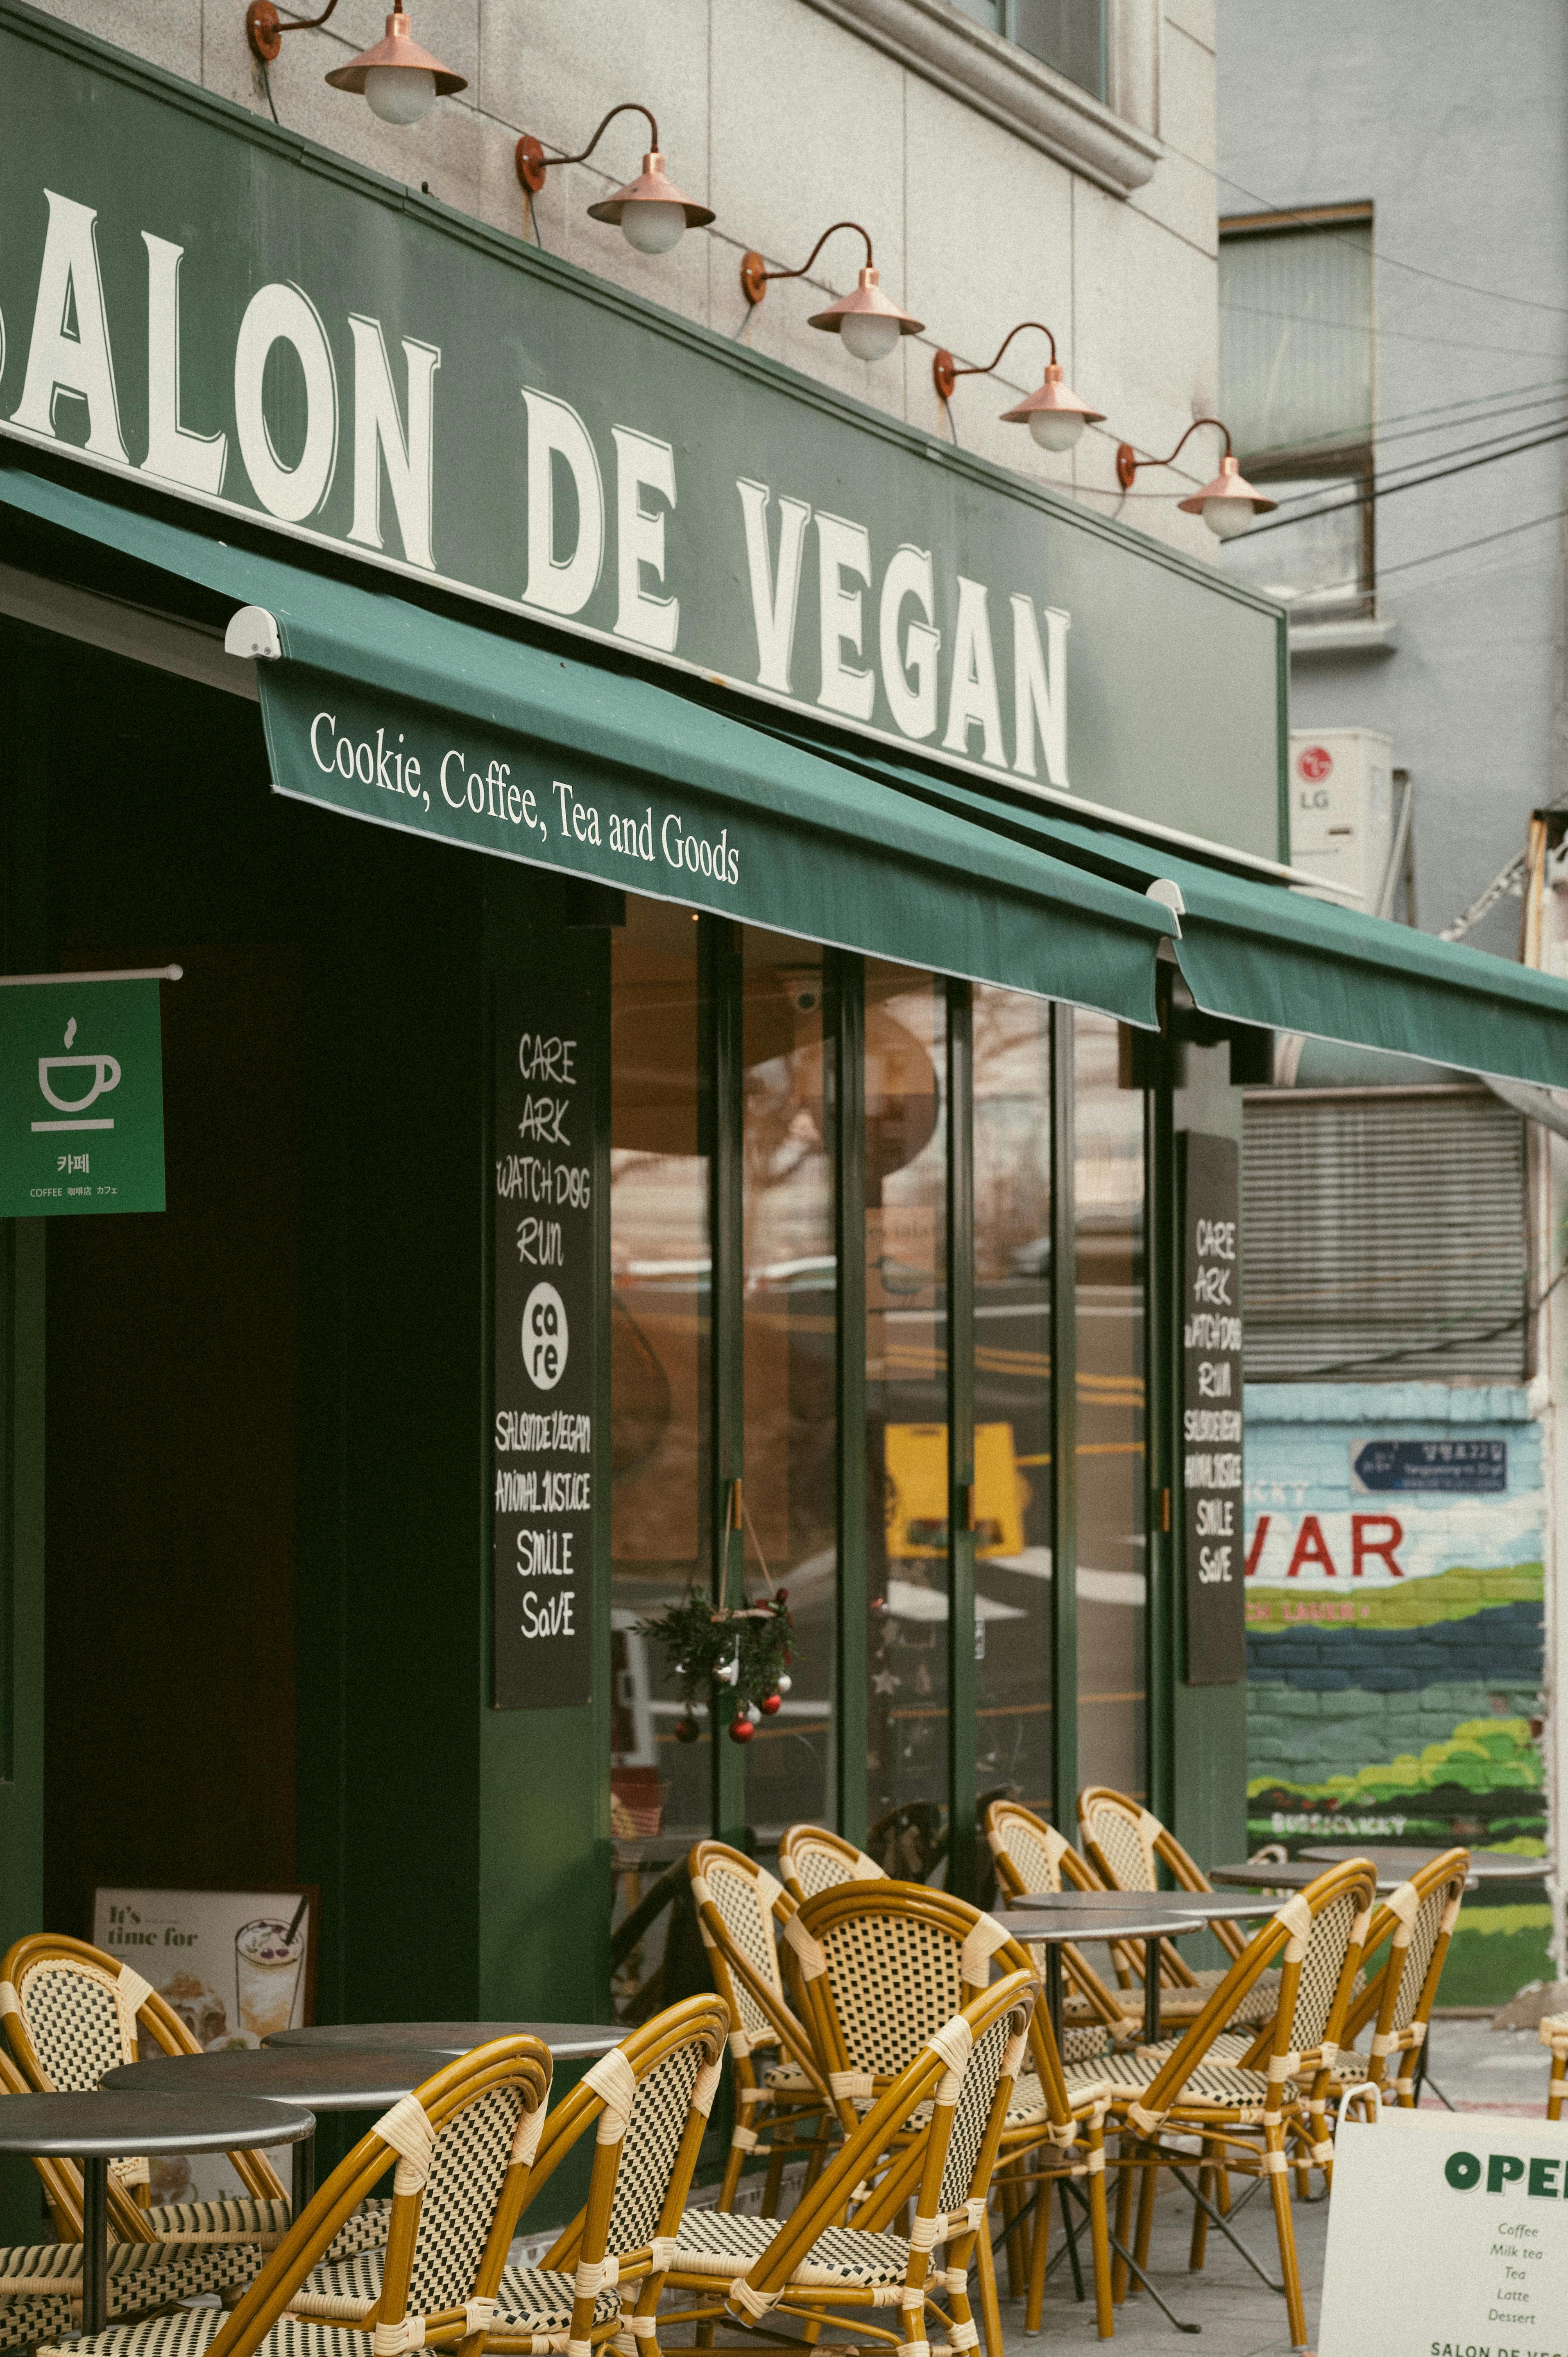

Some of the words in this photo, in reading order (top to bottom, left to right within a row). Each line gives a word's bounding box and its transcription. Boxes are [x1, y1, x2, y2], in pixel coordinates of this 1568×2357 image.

[0, 188, 441, 571] ALON
[522, 385, 679, 652] DE
[736, 476, 1070, 788] VEGAN
[310, 712, 431, 812] Cookie,
[440, 750, 547, 843] Coffee,
[553, 780, 601, 846] Tea
[609, 807, 655, 862] and
[661, 814, 739, 885] Goods
[1300, 790, 1330, 810] LG
[519, 1033, 577, 1084] CARE
[519, 1094, 571, 1146] ARK
[57, 1154, 89, 1174] 카페
[30, 1188, 62, 1197] COFFEE
[97, 1186, 117, 1194] カフェ
[109, 1906, 141, 1924] It's
[108, 1927, 158, 1945] time
[164, 1927, 198, 1946] for
[1445, 2151, 1568, 2198] OPE
[1498, 2223, 1539, 2238] Coffee
[1490, 2244, 1518, 2257] Milk
[1523, 2249, 1543, 2259] tea
[1505, 2266, 1526, 2280] Tea
[1497, 2288, 1530, 2302] Latte
[1489, 2308, 1536, 2324] Dessert
[1431, 2342, 1490, 2357] SALON
